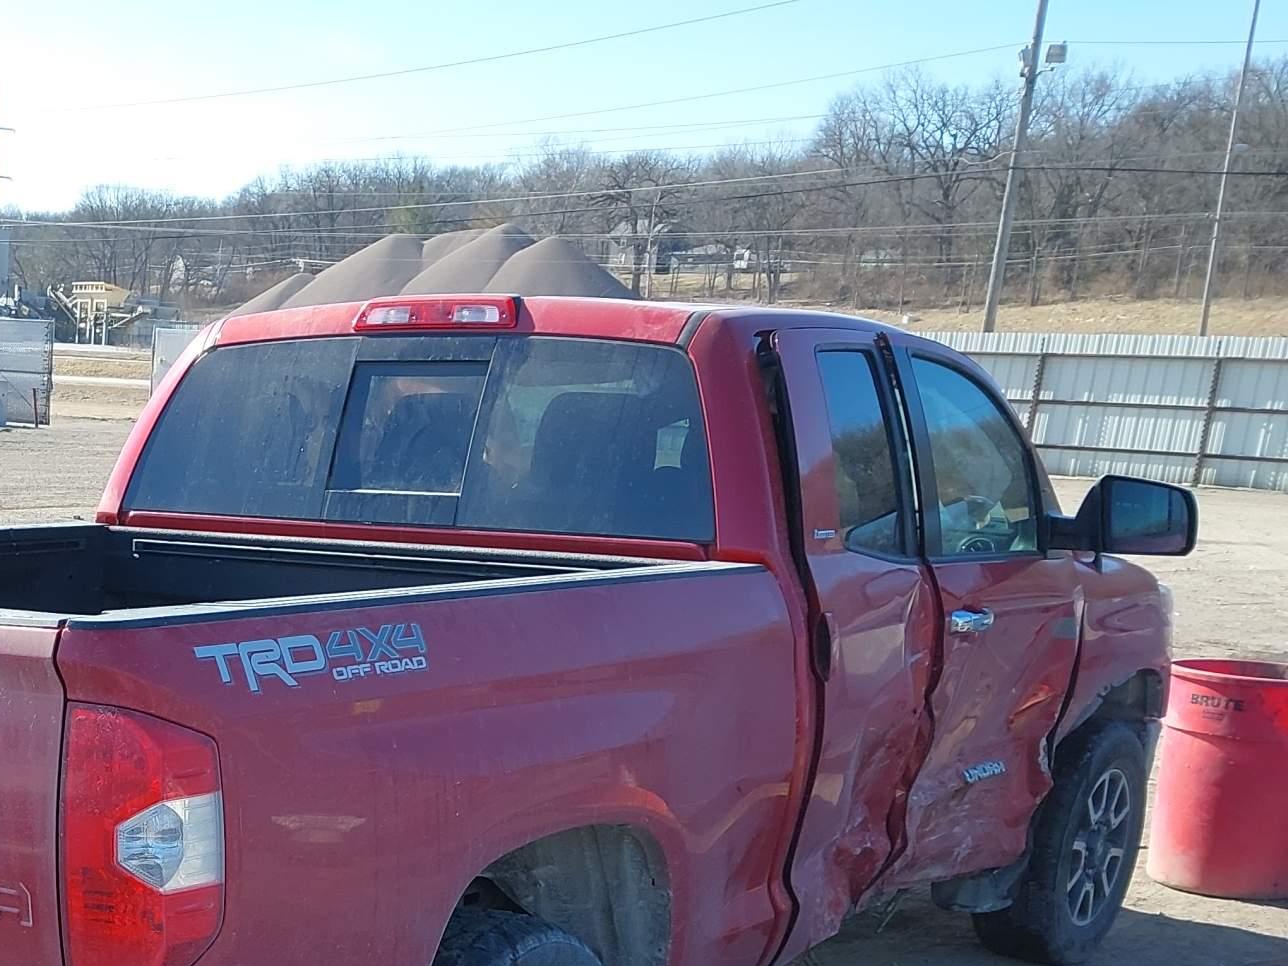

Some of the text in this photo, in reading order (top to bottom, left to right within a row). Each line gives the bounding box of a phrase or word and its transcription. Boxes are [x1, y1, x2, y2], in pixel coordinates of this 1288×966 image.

[194, 634, 328, 691] TRD
[332, 656, 427, 681] OFF ROAD
[1190, 693, 1246, 712] BRUTE
